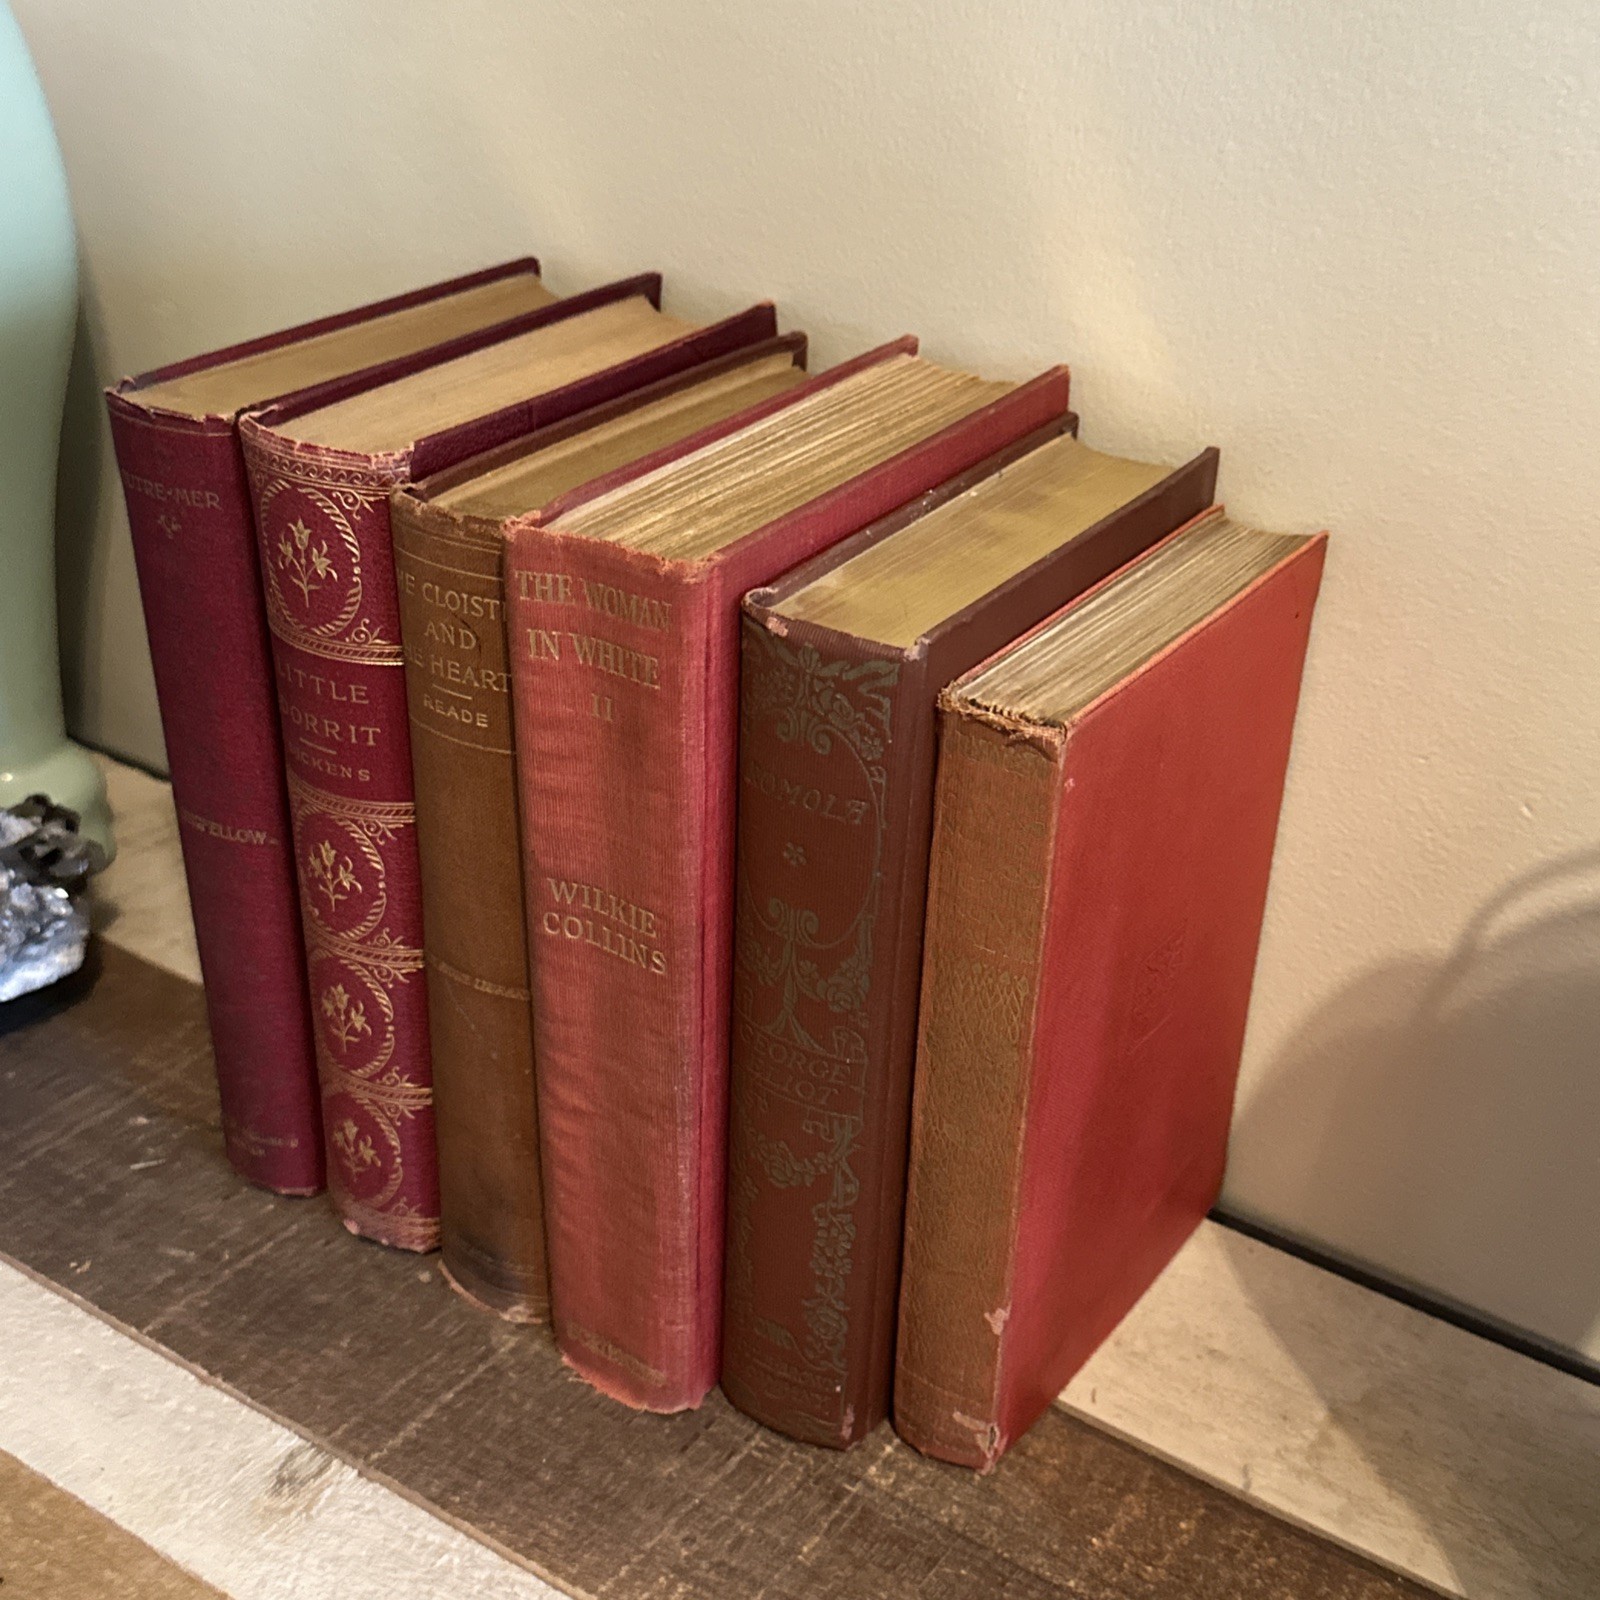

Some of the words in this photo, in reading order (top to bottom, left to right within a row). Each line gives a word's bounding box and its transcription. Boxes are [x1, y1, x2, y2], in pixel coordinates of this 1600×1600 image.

[422, 582, 506, 621] CLOIST
[514, 569, 576, 605] THE
[578, 577, 673, 634] WOMAN
[424, 620, 477, 651] AND
[526, 628, 562, 661] IN
[567, 631, 661, 691] WHITE
[275, 653, 370, 705] LITTLE
[431, 654, 512, 693] HEART
[278, 693, 382, 748] DORRIT
[423, 693, 489, 729] READE
[590, 691, 614, 724] II
[546, 877, 658, 938] WILKIE
[542, 911, 668, 976] COLLINS
